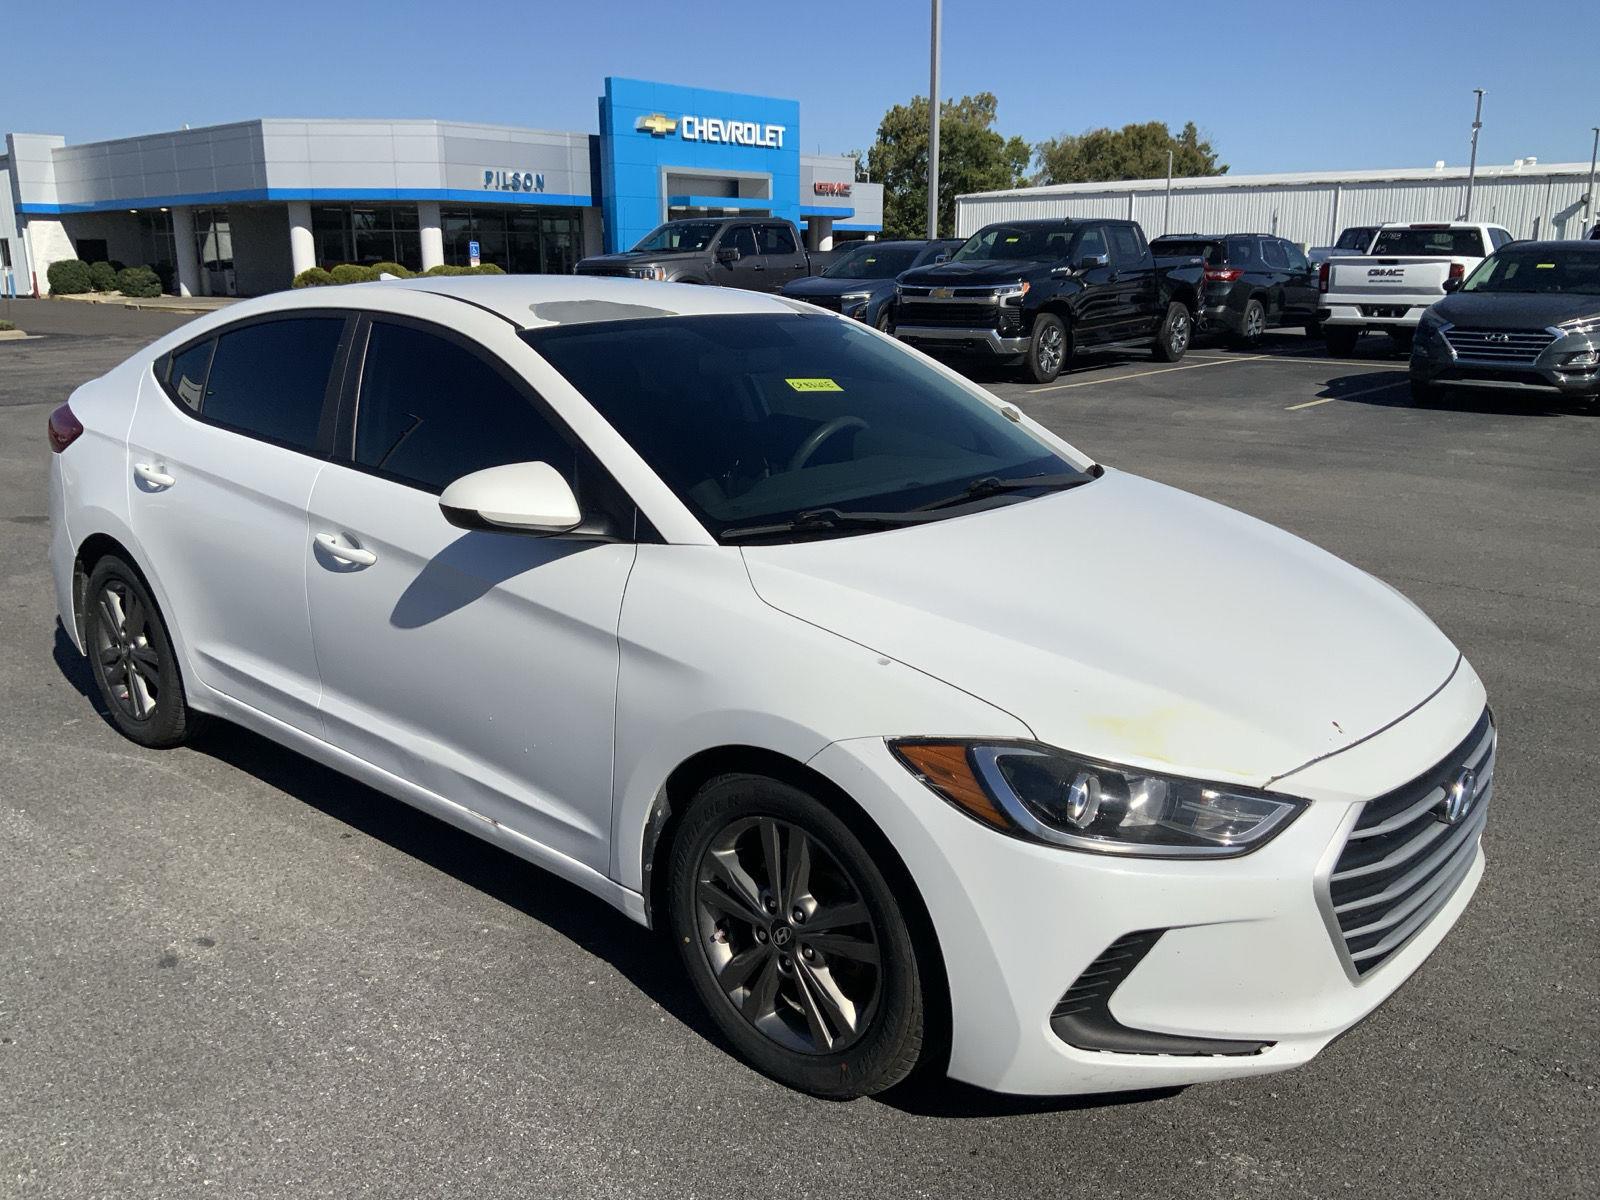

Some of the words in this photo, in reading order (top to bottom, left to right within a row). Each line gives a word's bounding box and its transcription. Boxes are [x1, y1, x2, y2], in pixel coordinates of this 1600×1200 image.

[682, 115, 786, 148] CHEVROLET
[484, 170, 545, 191] PILSON
[1367, 268, 1405, 277] GMC
